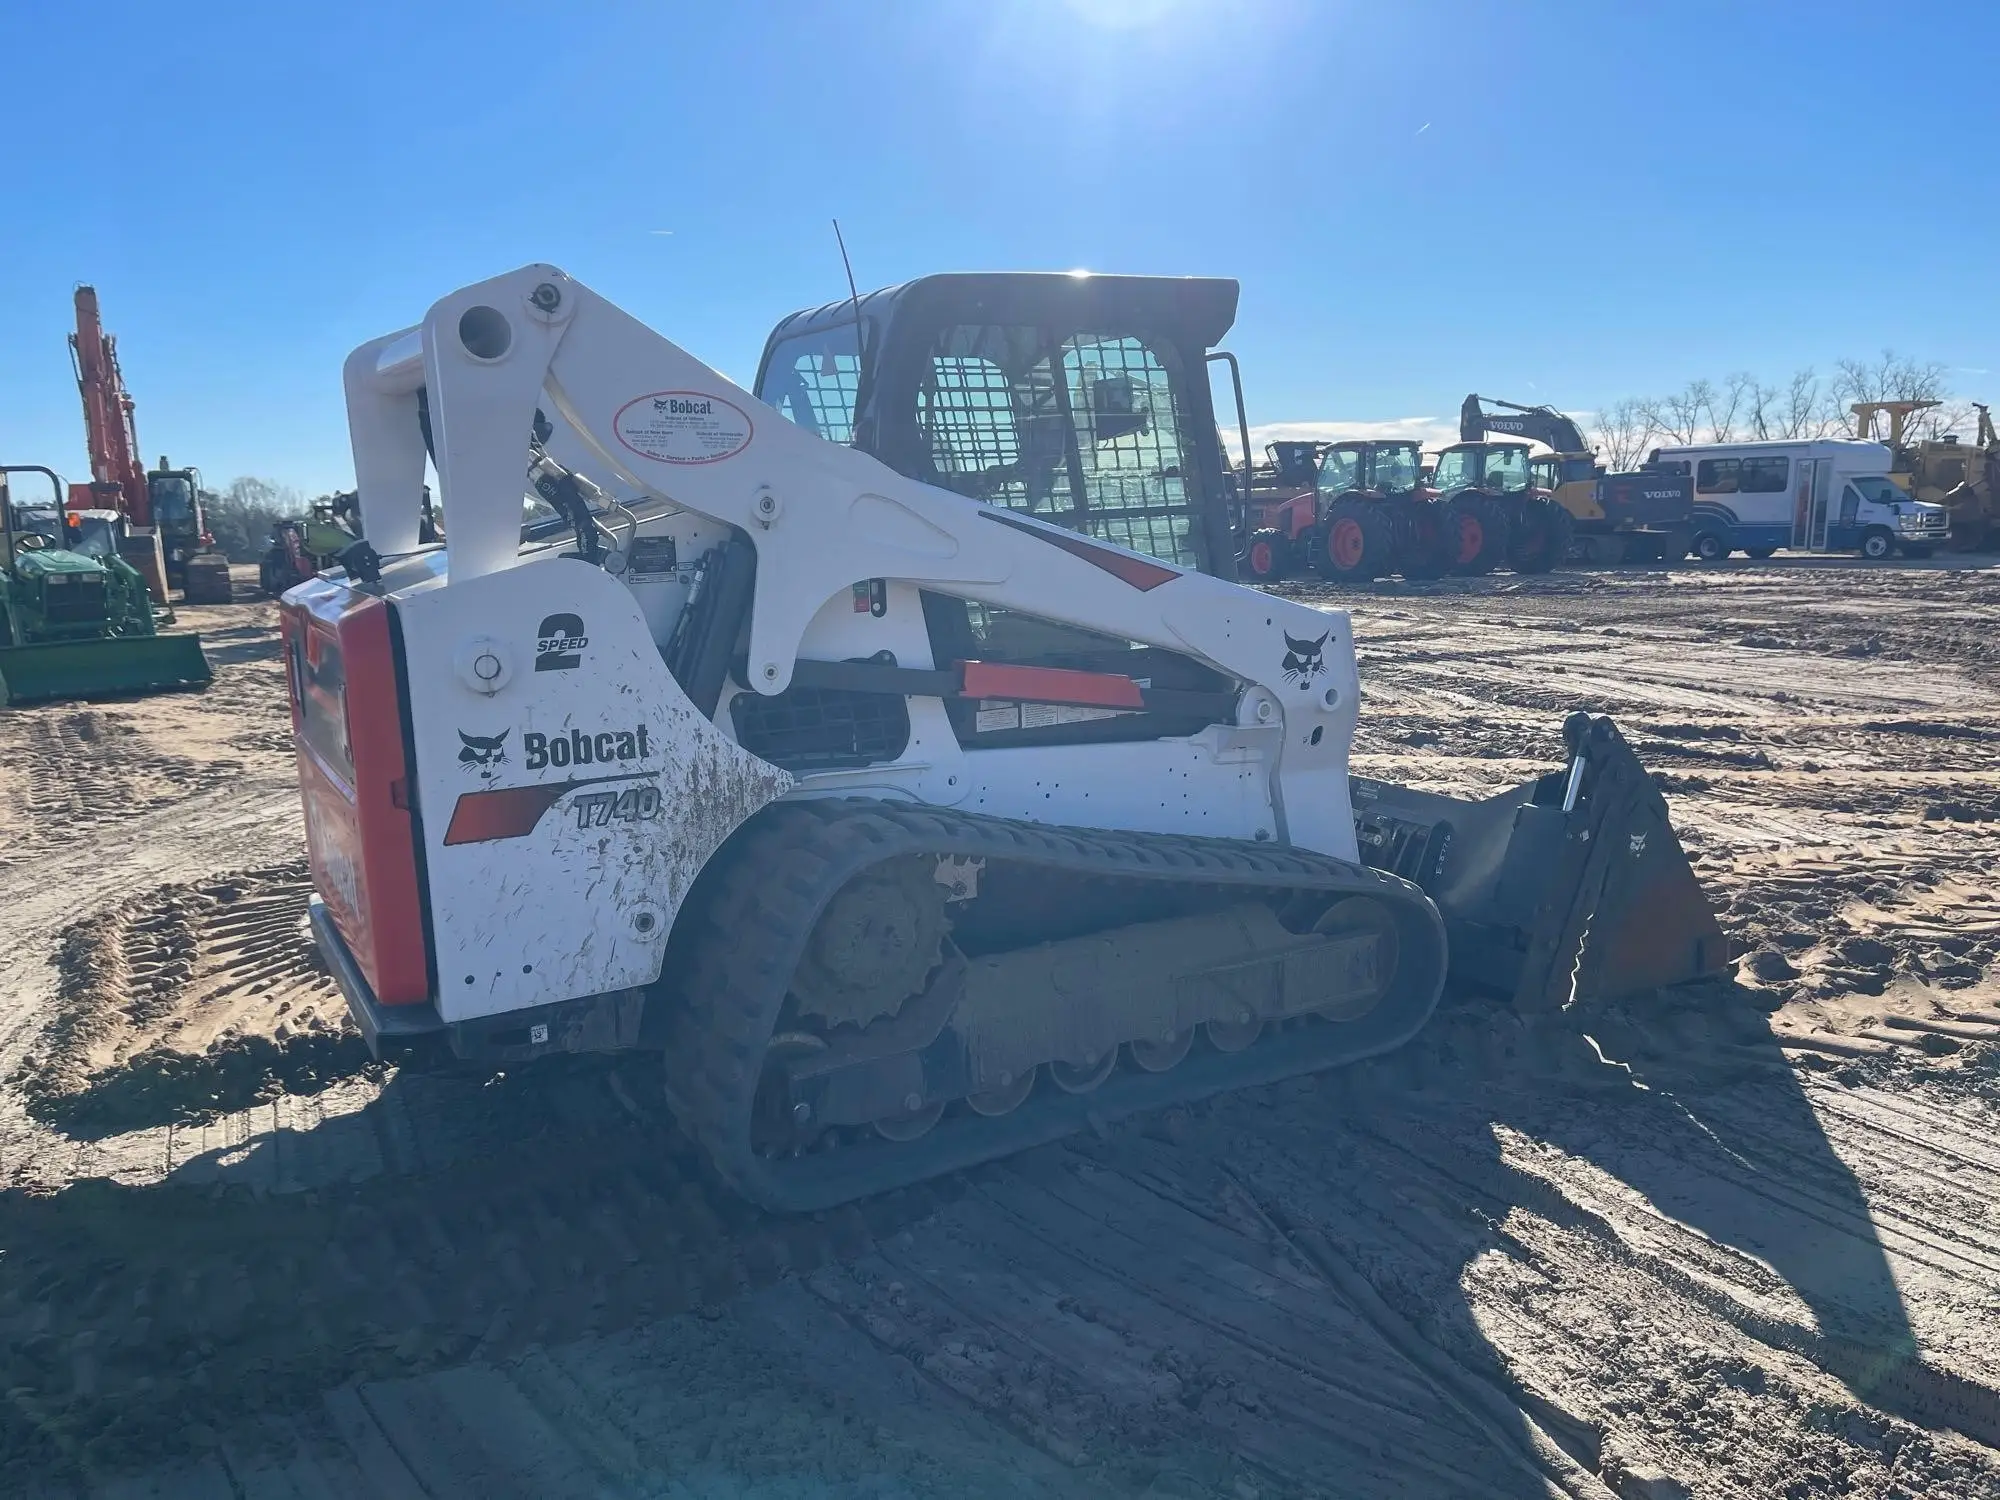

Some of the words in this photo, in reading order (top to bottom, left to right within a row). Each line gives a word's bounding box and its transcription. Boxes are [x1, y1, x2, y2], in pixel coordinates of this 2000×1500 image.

[670, 399, 712, 415] Bobcat
[1490, 421, 1524, 431] VOLVO
[1643, 489, 1681, 499] VOLVO
[535, 612, 585, 672] 2
[536, 637, 589, 653] SPEED
[524, 724, 650, 771] Bobcat
[574, 786, 661, 829] T740
